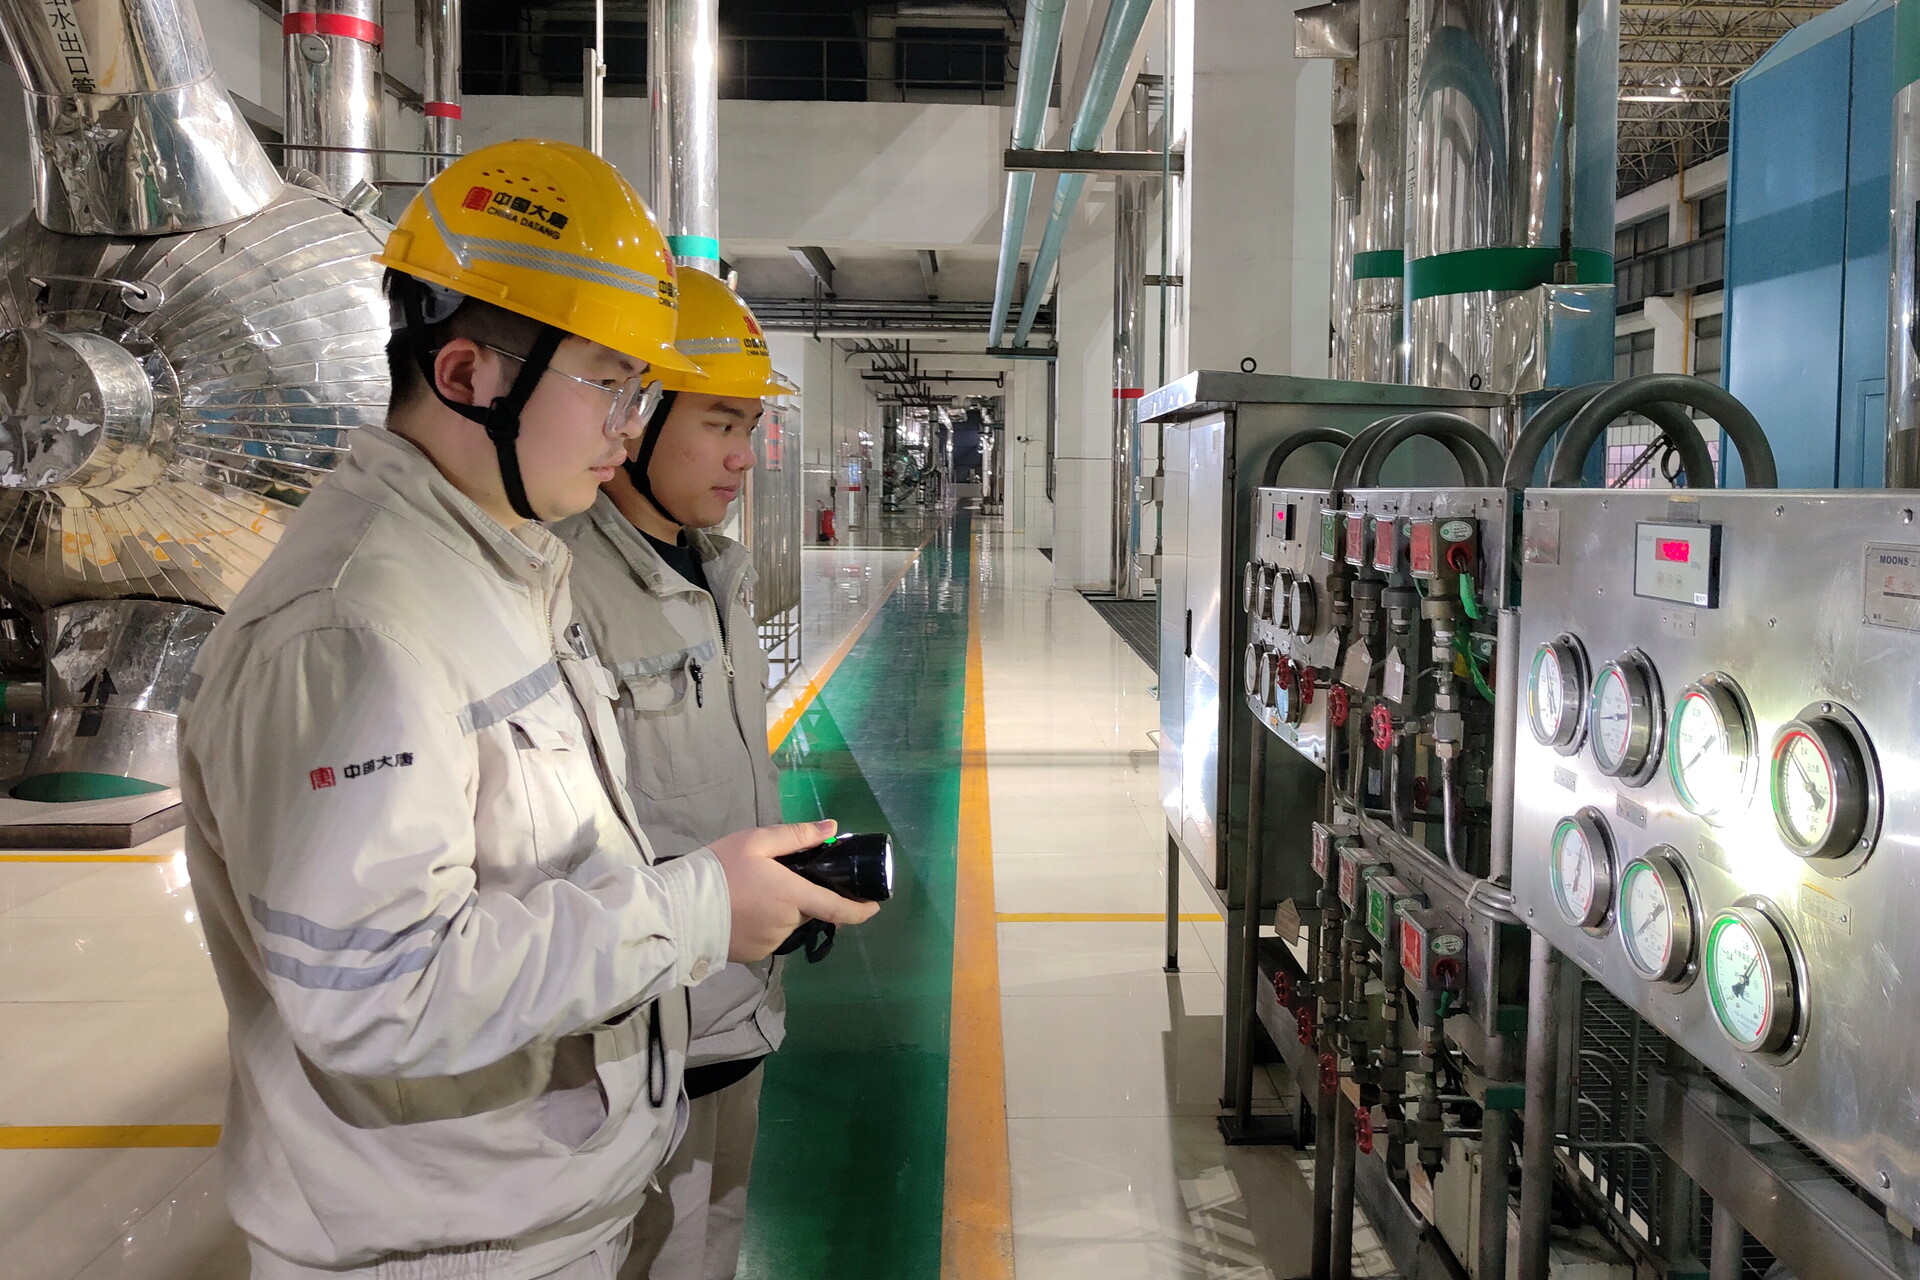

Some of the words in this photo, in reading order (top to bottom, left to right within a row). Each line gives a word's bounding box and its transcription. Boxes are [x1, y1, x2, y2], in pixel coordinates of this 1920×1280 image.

[486, 206, 518, 222] CHINA
[520, 217, 560, 240] DATANG
[493, 192, 569, 230] 中国大唐
